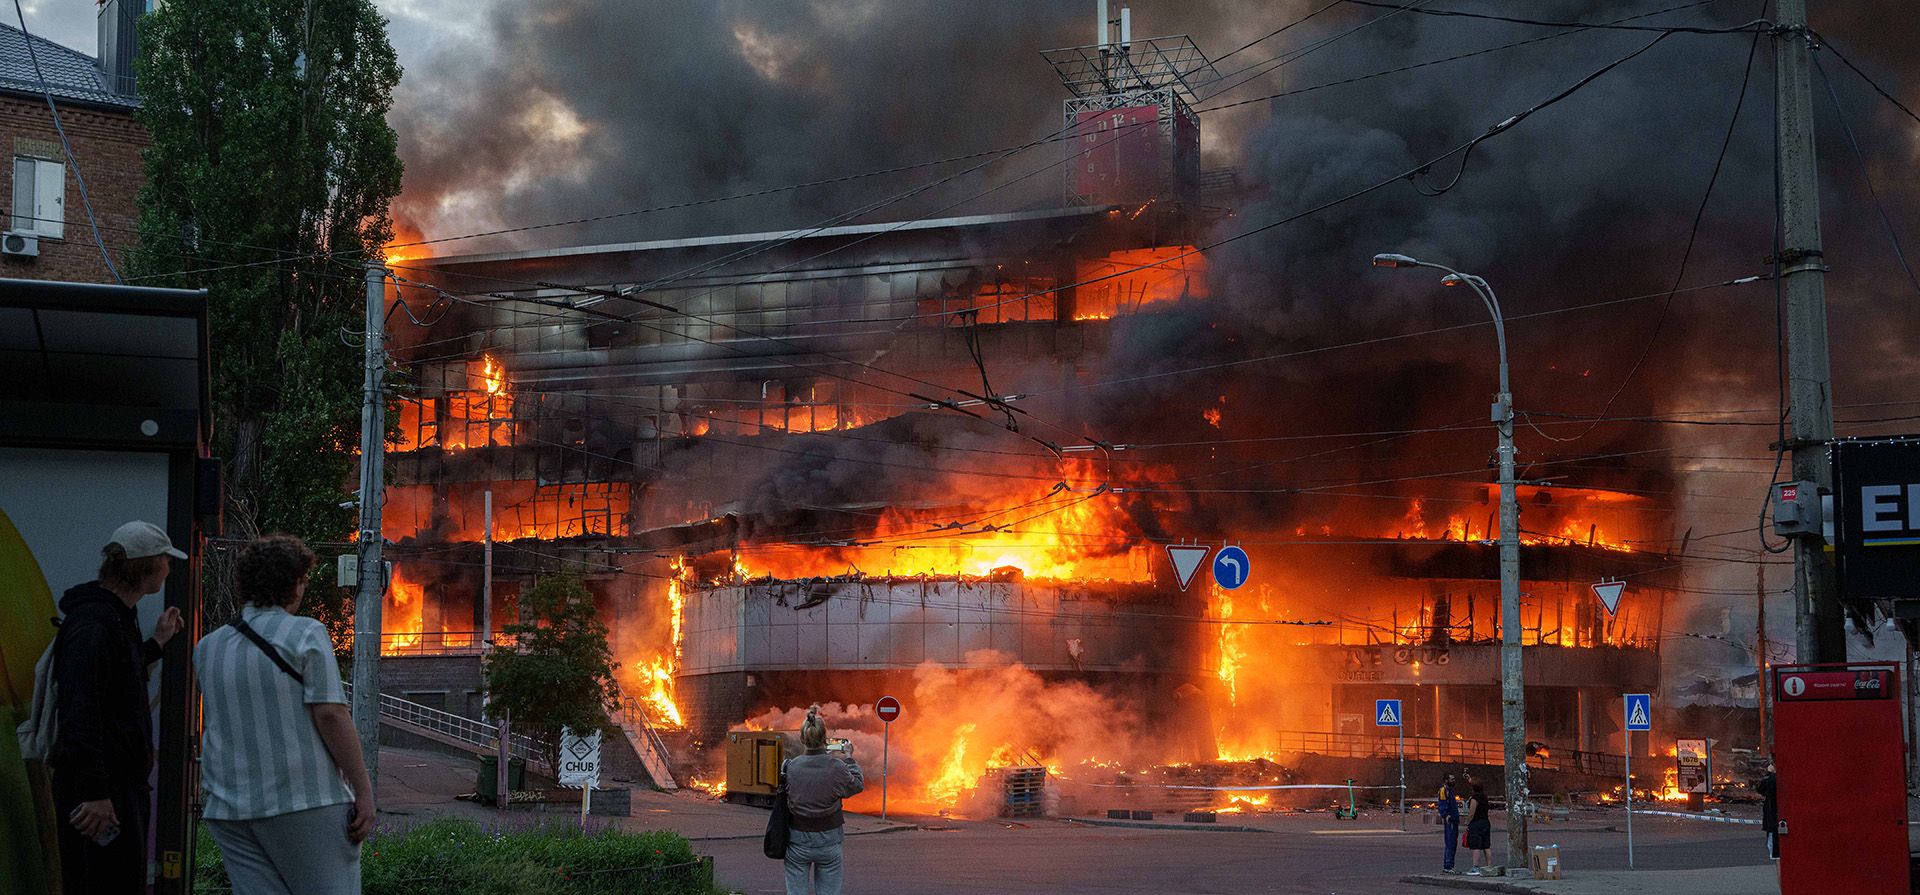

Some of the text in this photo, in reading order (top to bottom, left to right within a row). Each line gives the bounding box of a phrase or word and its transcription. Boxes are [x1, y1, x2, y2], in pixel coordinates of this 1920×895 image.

[1097, 120, 1107, 130] 11
[1085, 133, 1096, 142] 10
[1087, 163, 1095, 173] 8
[1783, 489, 1796, 497] 225
[565, 761, 594, 772] CHUB
